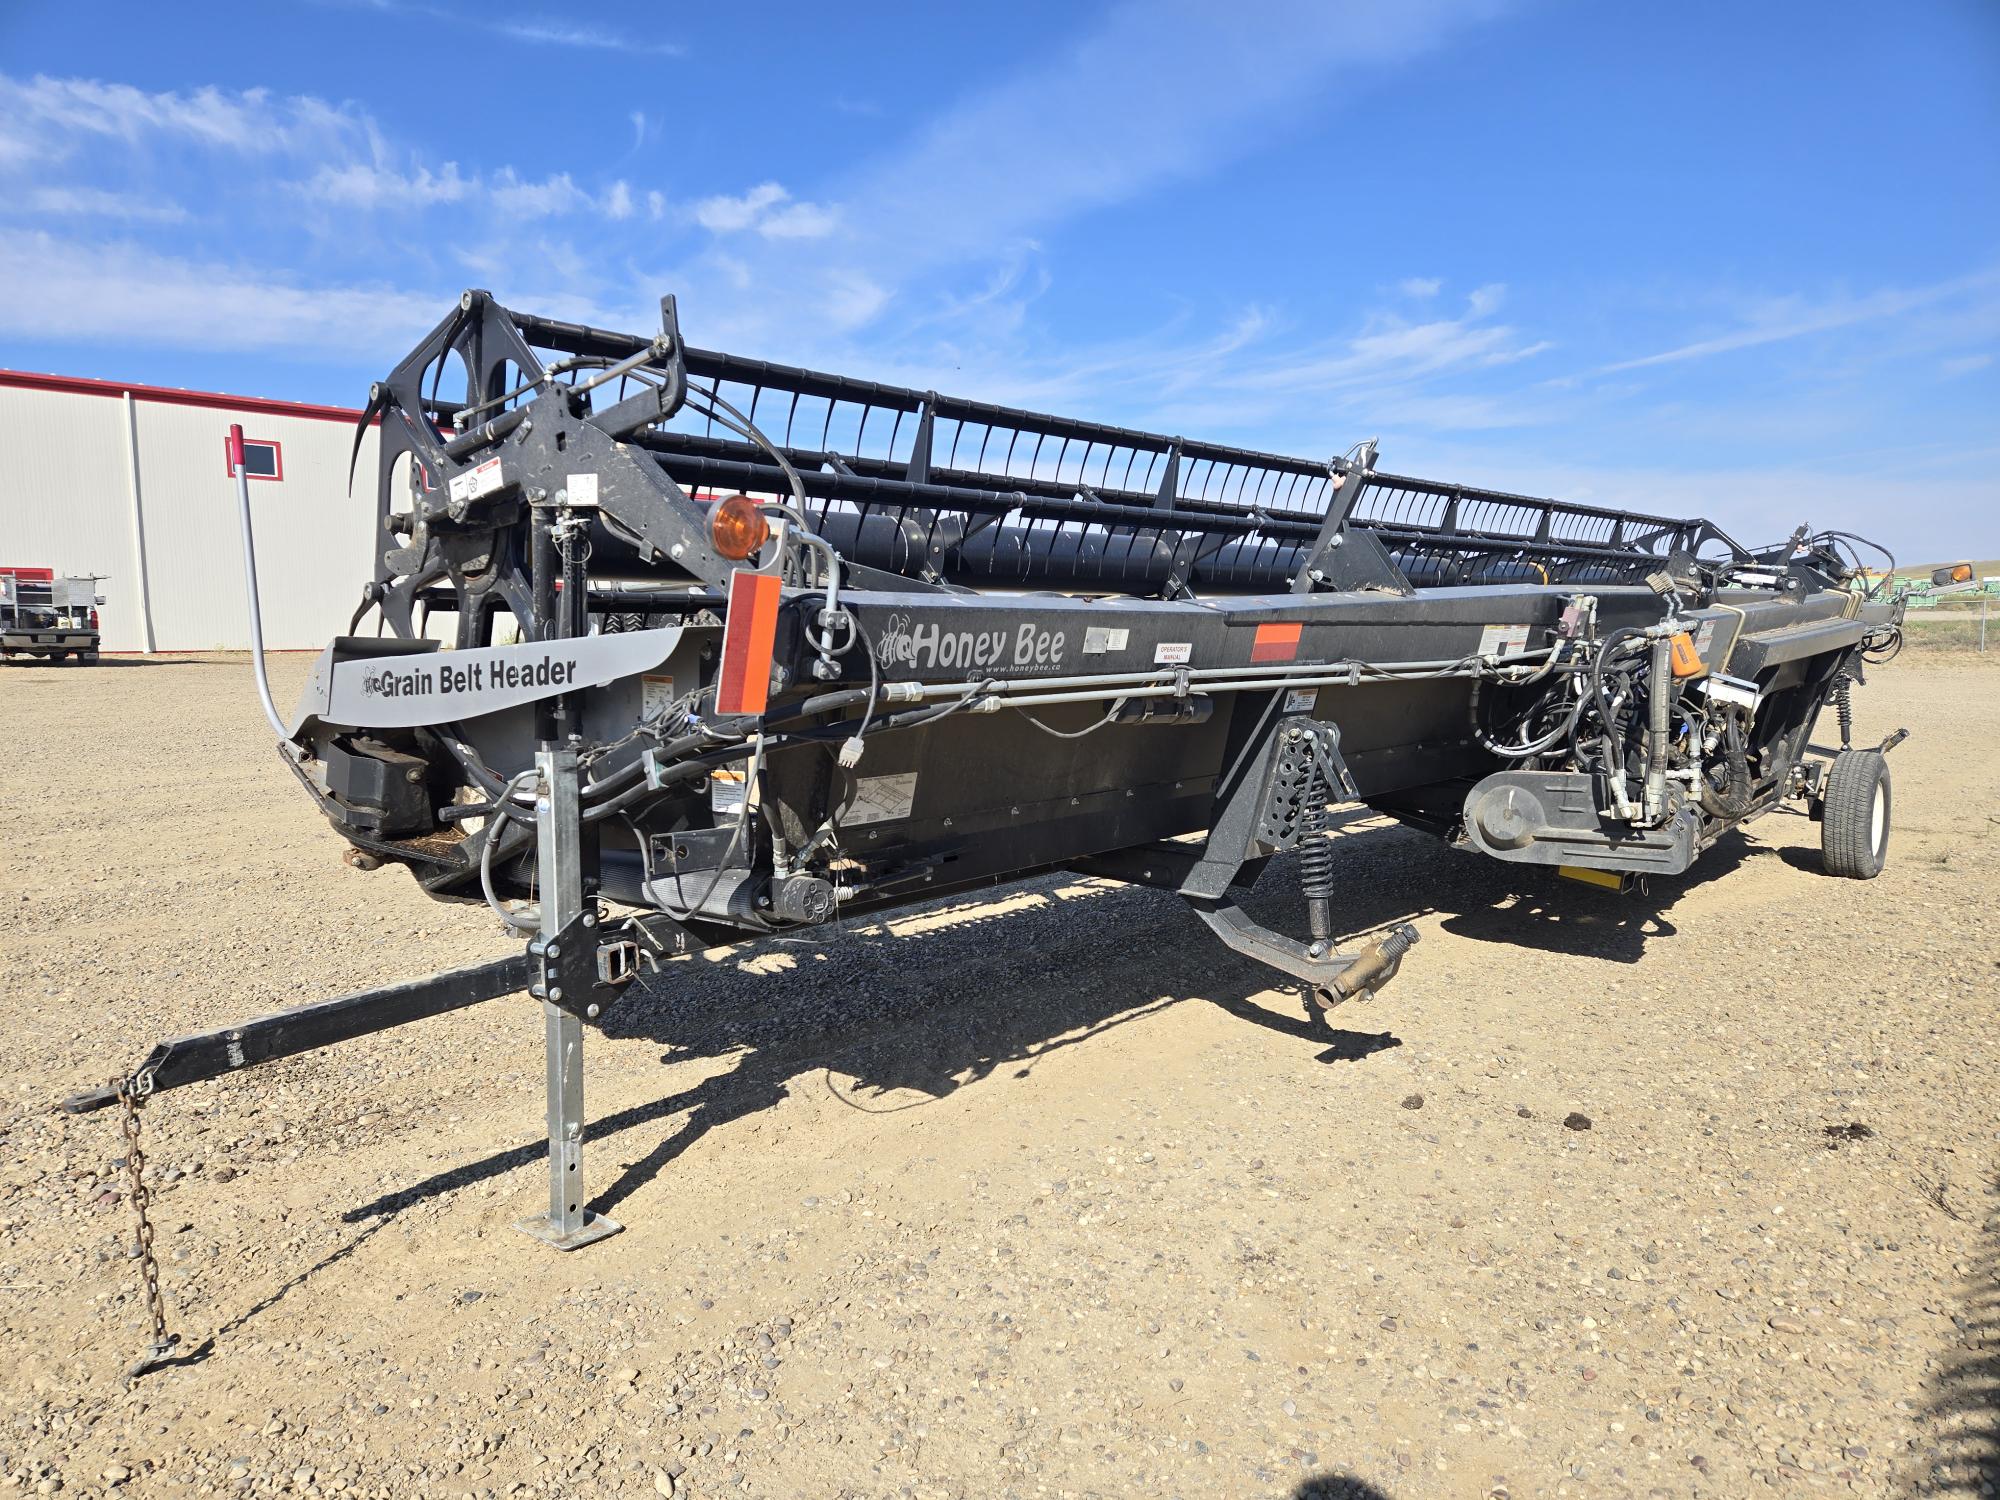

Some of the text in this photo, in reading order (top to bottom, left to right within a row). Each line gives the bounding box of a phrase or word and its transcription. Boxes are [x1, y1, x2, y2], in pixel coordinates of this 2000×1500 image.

[909, 623, 1007, 669] Honey
[1014, 623, 1065, 665] Bee
[1160, 645, 1188, 653] OPERATOR'S
[380, 655, 577, 697] Grain Belt Header
[985, 664, 1061, 674] www.honeybee.ca
